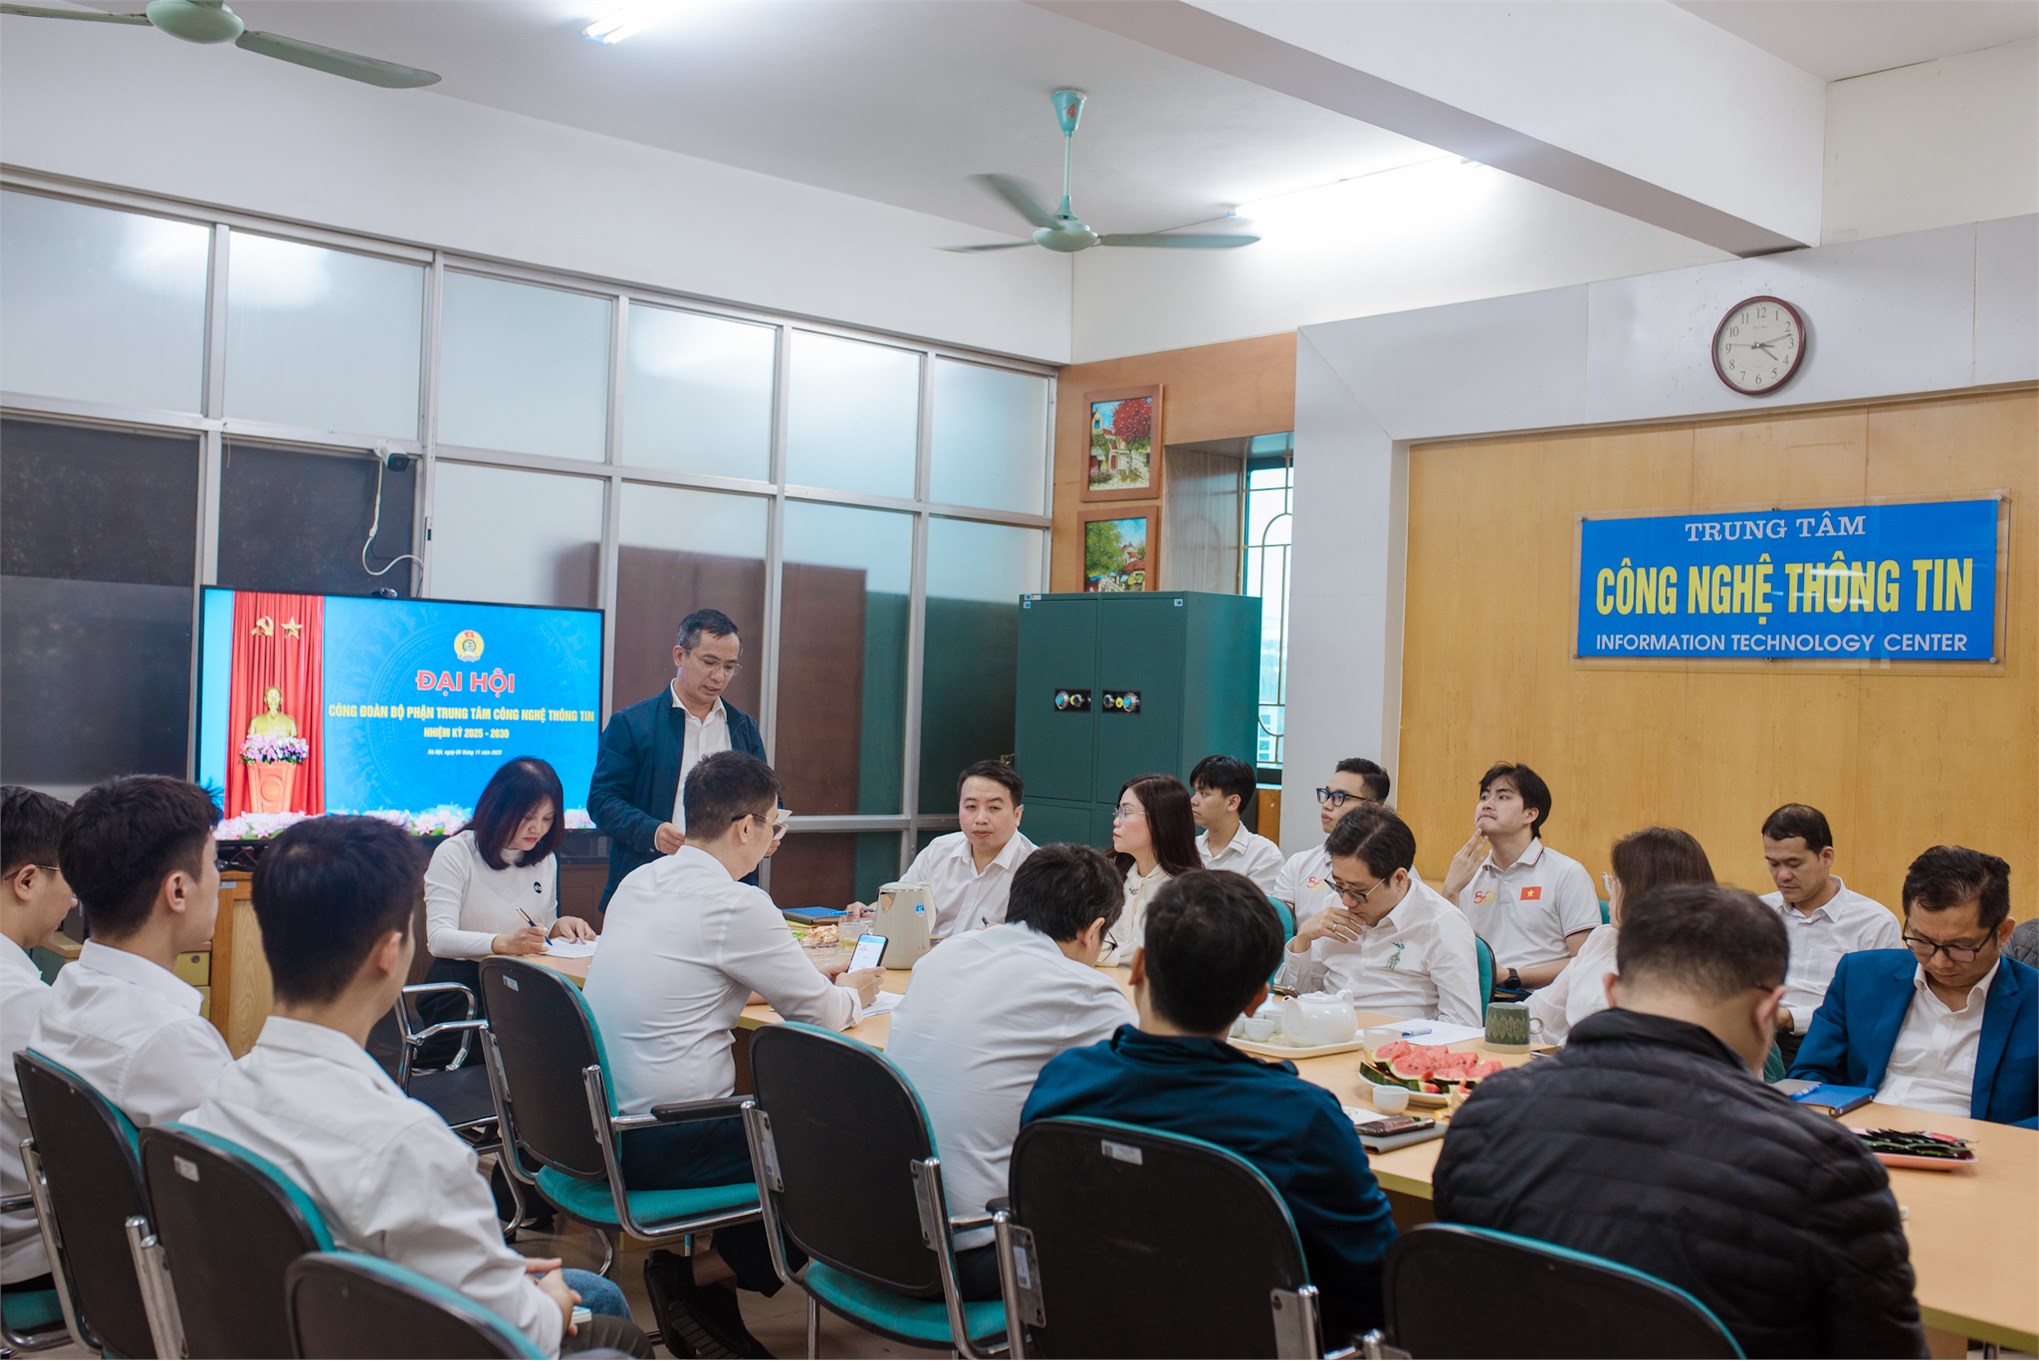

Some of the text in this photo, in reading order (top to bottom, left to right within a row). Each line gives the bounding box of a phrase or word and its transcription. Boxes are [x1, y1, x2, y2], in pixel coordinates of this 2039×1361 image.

[1067, 103, 1076, 118] 4
[1756, 307, 1767, 318] 12
[1775, 311, 1778, 321] 1
[1741, 314, 1749, 324] 11
[1729, 327, 1739, 337] 10
[1785, 321, 1791, 332] 2
[1725, 343, 1732, 354] 9
[1788, 338, 1794, 349] 3
[1729, 359, 1735, 370] 8
[1783, 355, 1789, 365] 4
[1740, 371, 1746, 381] 7
[1755, 374, 1762, 384] 6
[1771, 368, 1777, 379] 5
[1685, 511, 1866, 542] TRUNG TÂM
[1596, 551, 1973, 625] CÔNG NGHỆ THÔNG TIN
[1596, 633, 1968, 653] INFORMATION TECHNOLOGY CENTER
[416, 668, 515, 698] ĐẠI HỘI
[329, 703, 594, 724] CÔNG ĐOÀN BỘ PHẬN TRUNG TÂM CÔNG NGHỆ THÔNG TIN
[423, 728, 451, 739] NHIỆM
[464, 728, 483, 739] 2025
[490, 728, 509, 739] 2030
